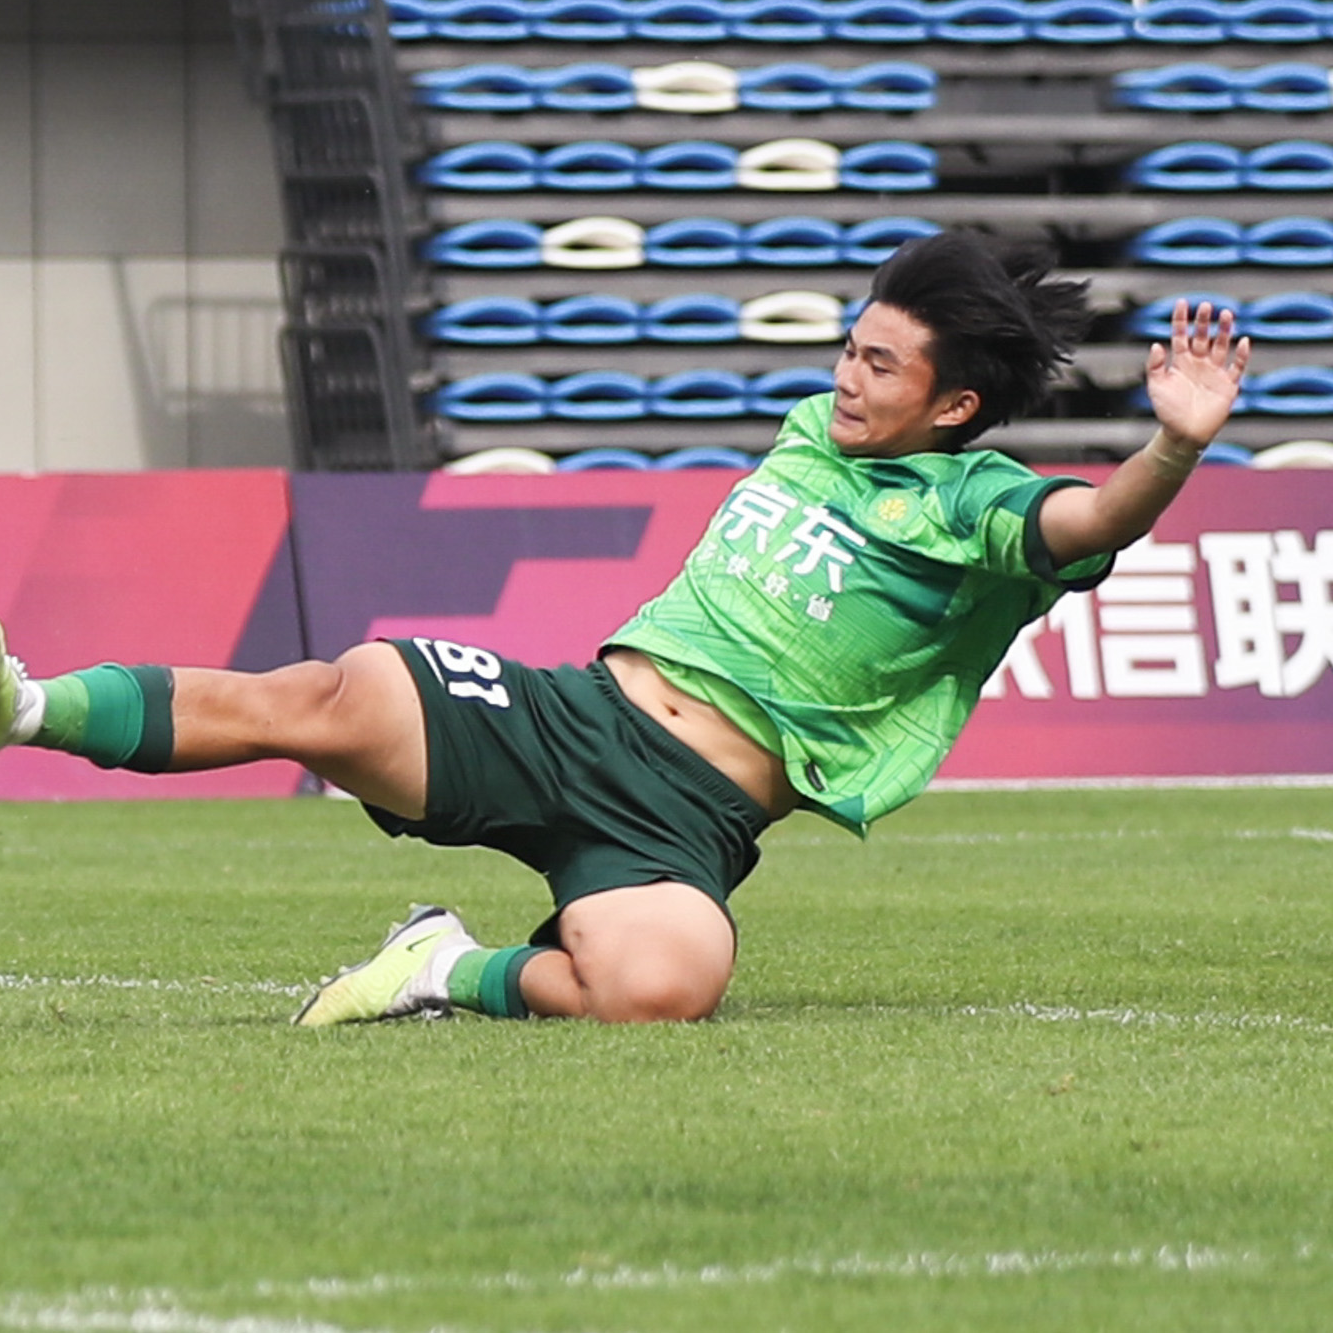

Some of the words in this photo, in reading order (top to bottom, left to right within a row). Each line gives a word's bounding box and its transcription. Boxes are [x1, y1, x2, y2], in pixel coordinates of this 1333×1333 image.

[712, 481, 868, 595] 京东
[981, 531, 1333, 699] 信联
[434, 639, 511, 708] 81
